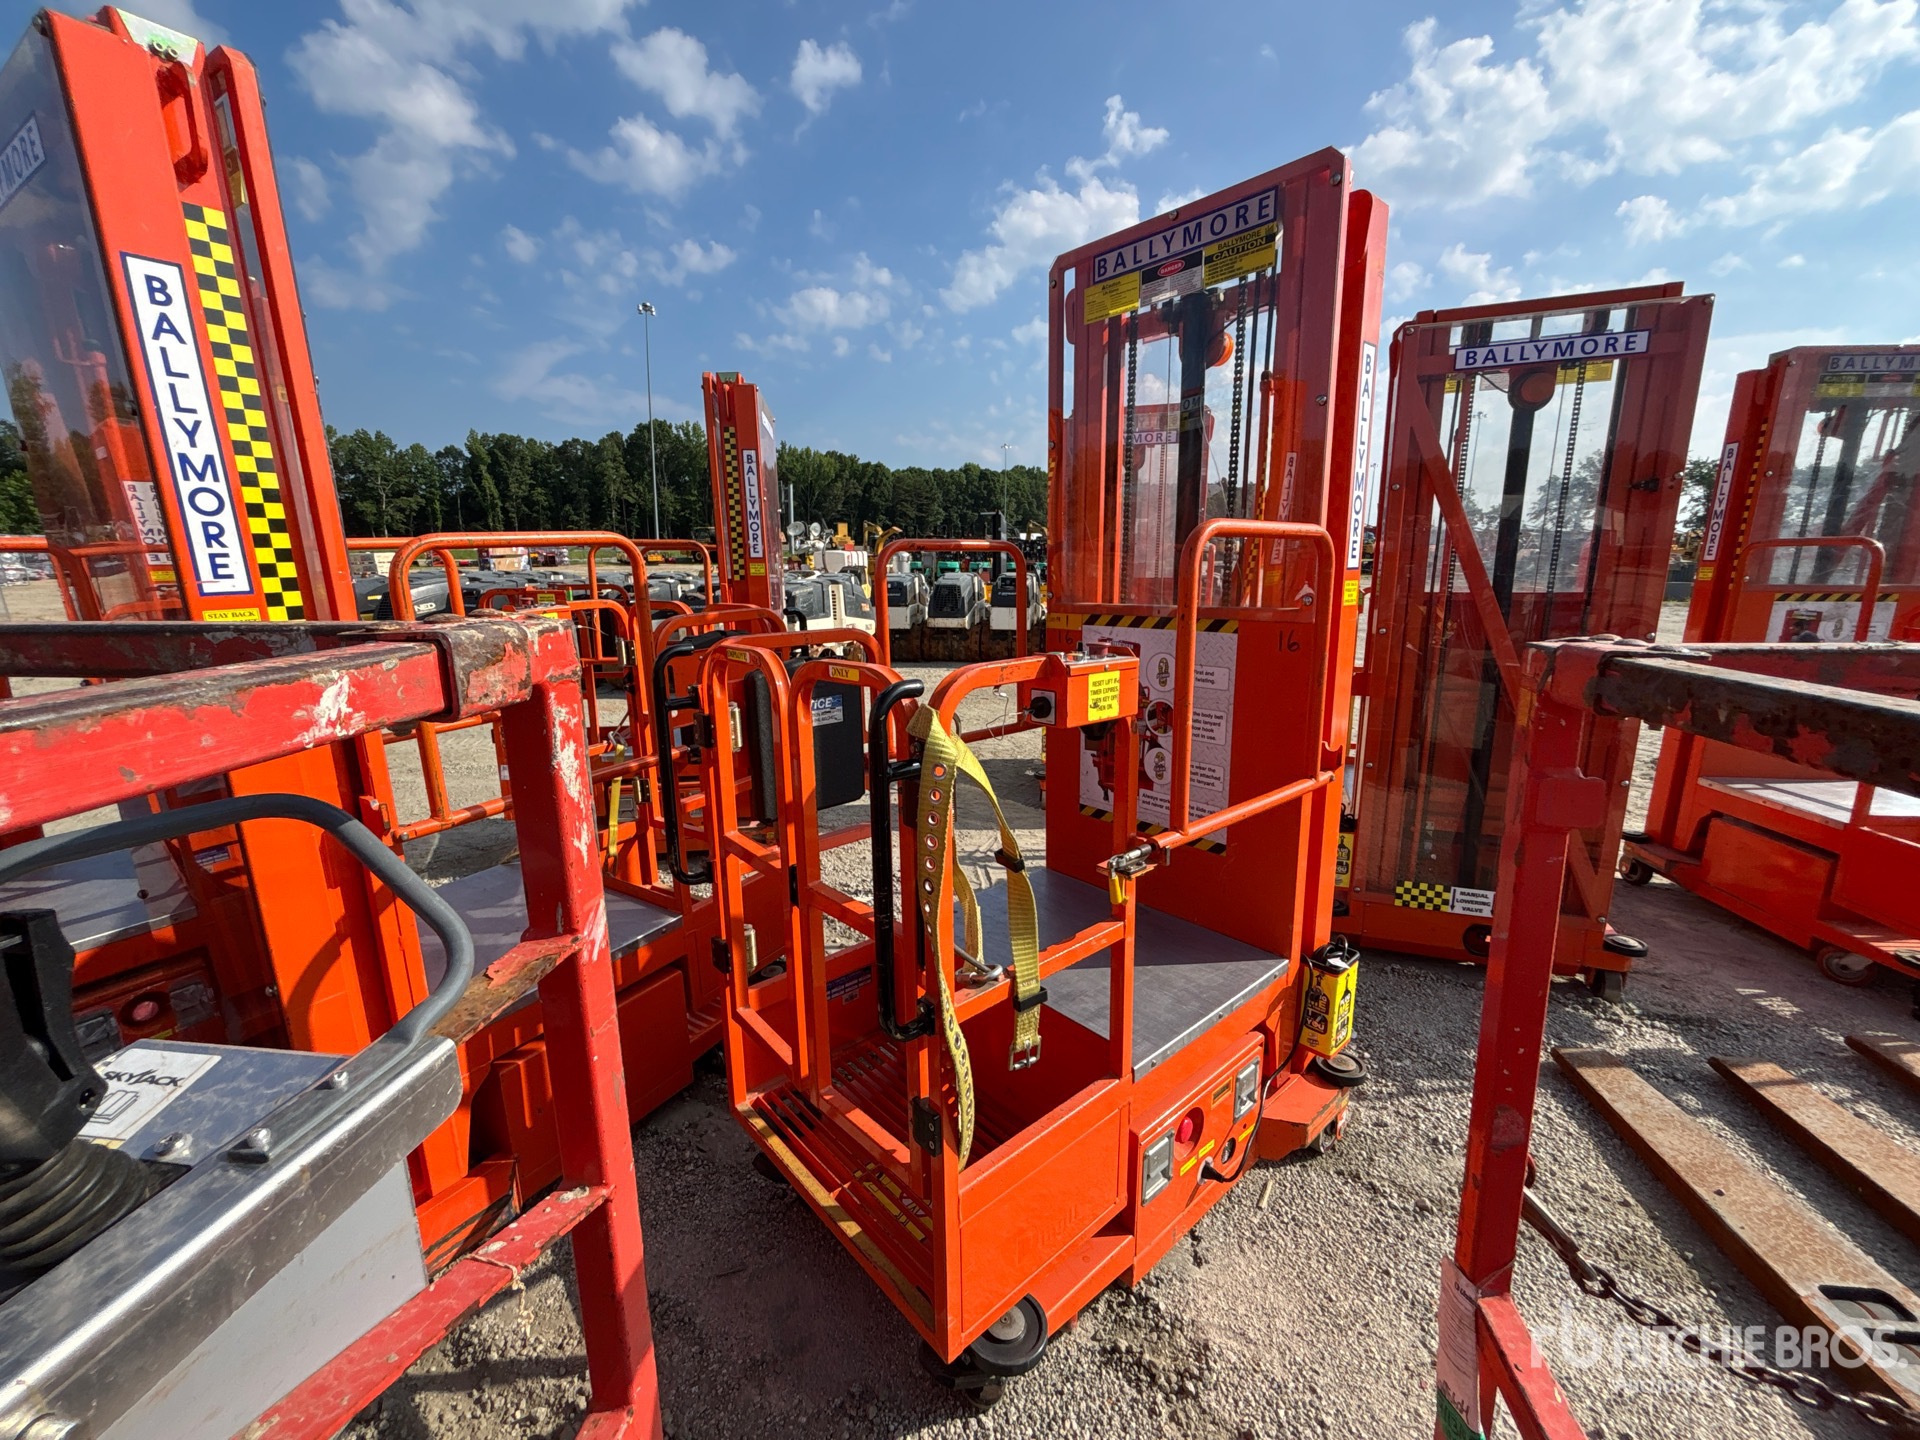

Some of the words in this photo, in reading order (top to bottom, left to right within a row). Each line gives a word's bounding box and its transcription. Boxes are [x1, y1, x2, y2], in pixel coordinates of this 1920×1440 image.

[1096, 193, 1272, 278] BALLYMORE
[1217, 230, 1262, 250] BALLYMORE
[1212, 237, 1266, 261] CAUTION
[1160, 262, 1182, 274] DANGER
[1463, 334, 1638, 366] BALLYMORE
[144, 273, 235, 580] BALLYMORE
[1350, 353, 1373, 560] BALLYMORE
[746, 454, 760, 554] BALLYMORE
[1706, 448, 1734, 556] BALLYMORE
[207, 612, 229, 620] STAY
[1278, 629, 1300, 652] 16
[1092, 679, 1105, 688] RESET
[1090, 688, 1102, 696] TIMER
[1201, 712, 1213, 720] body
[1203, 719, 1221, 727] lanyard
[1200, 772, 1221, 781] attached
[1142, 793, 1159, 801] Always
[1460, 891, 1489, 899] MANUAL
[1456, 898, 1491, 907] LOWERING
[1461, 906, 1484, 914] VALVE
[103, 1068, 186, 1087] SKYJACK
